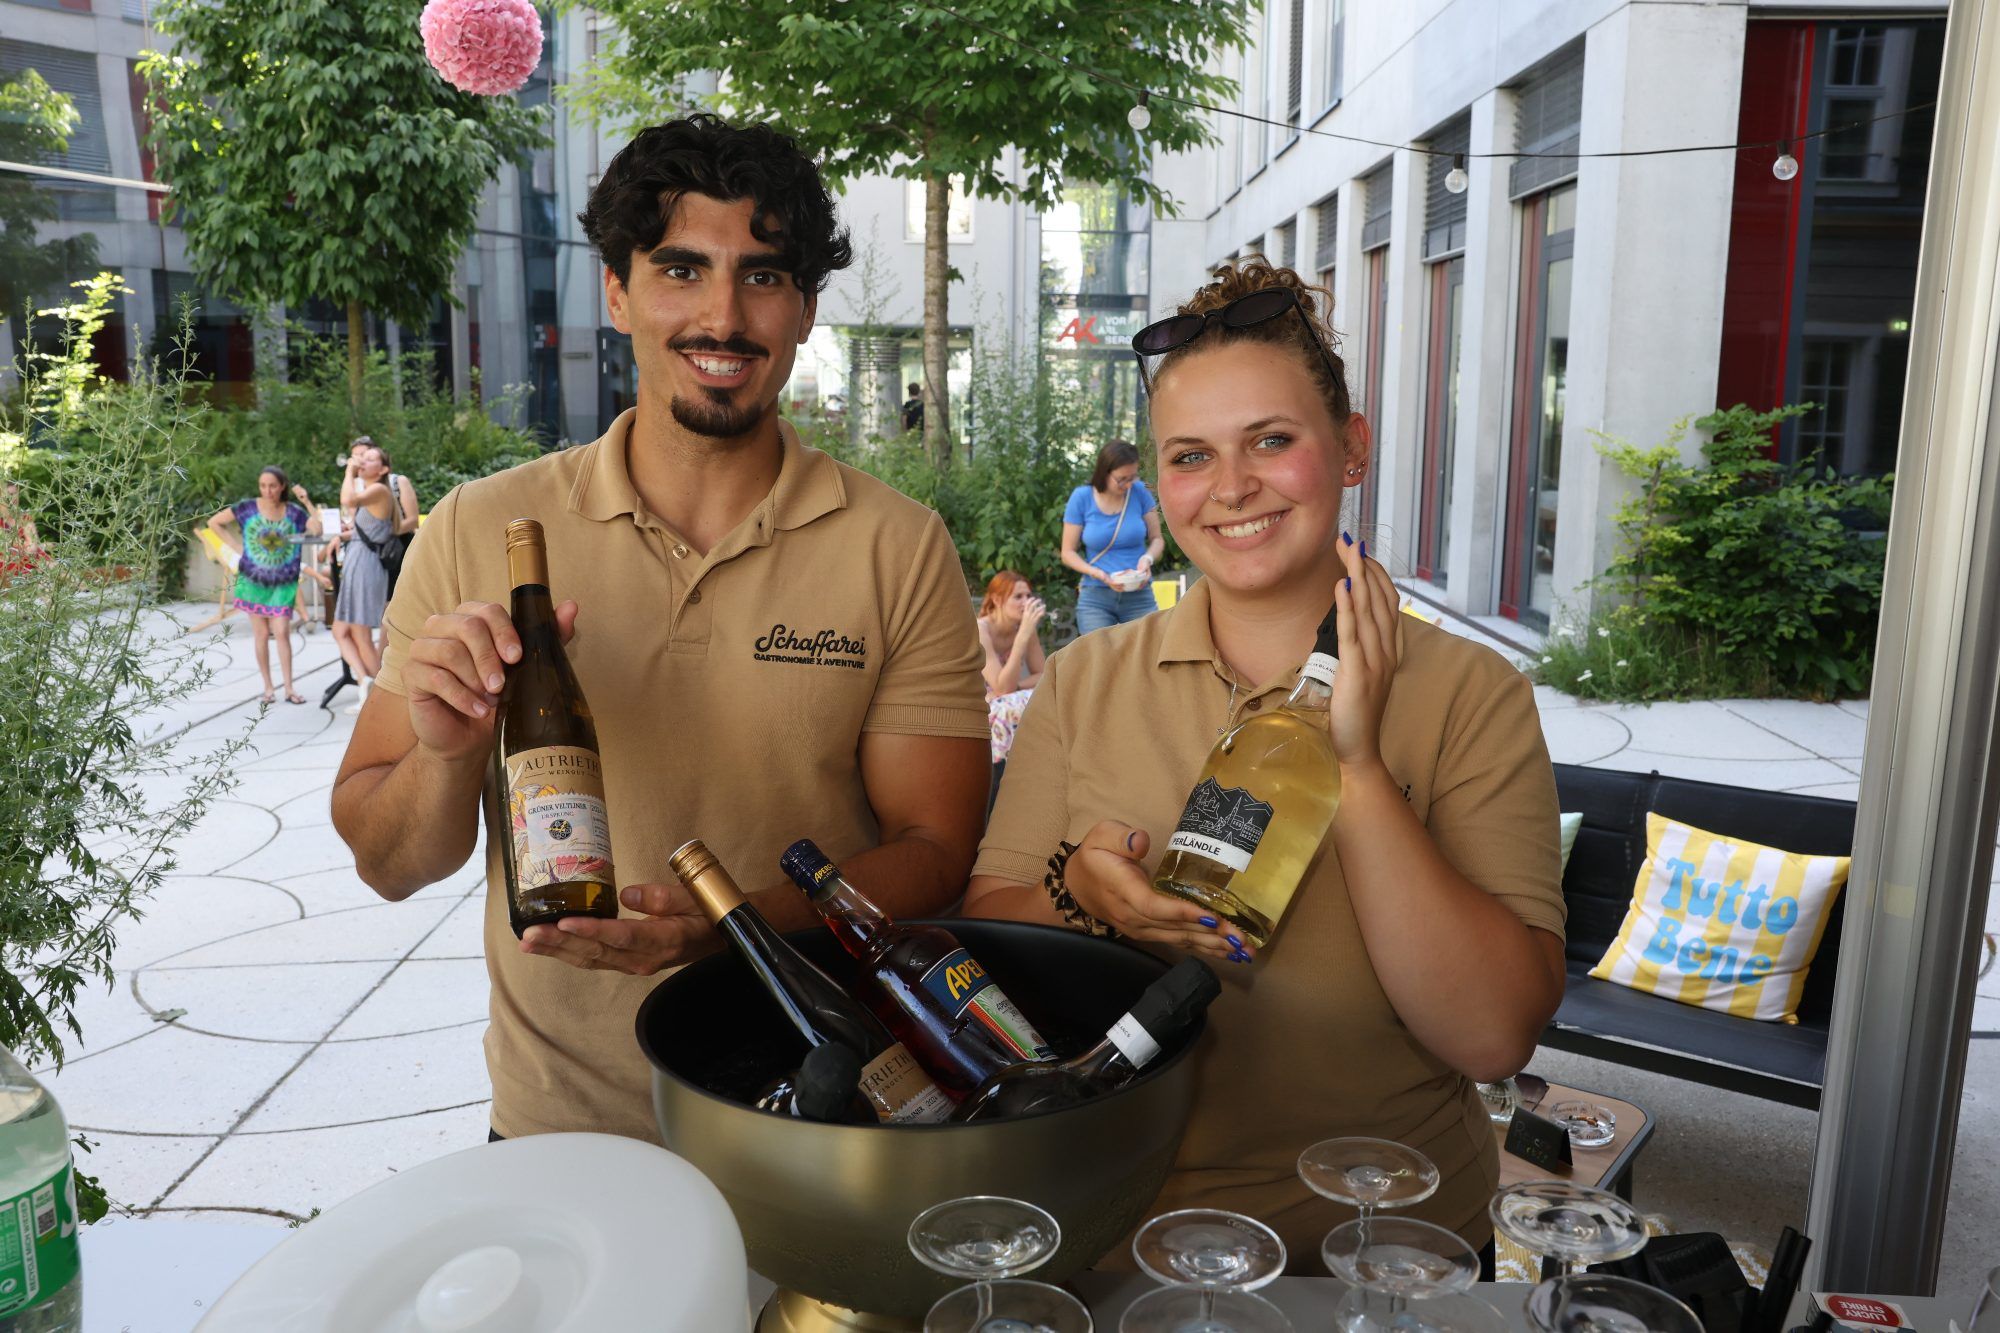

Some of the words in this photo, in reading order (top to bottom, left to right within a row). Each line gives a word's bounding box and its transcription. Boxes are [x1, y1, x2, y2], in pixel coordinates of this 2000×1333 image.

[1056, 316, 1099, 345] AK
[1104, 316, 1127, 326] VOR
[754, 624, 866, 657] Schaffarei
[754, 653, 816, 665] GASTRONOMIE
[816, 658, 822, 666] X
[823, 658, 865, 669] AVENTURE
[525, 755, 599, 773] AUTRIETH
[528, 803, 554, 815] GRÜNER
[554, 802, 588, 810] VELTLINER
[1661, 857, 1798, 935] Tutto
[1642, 916, 1773, 986] Bene
[860, 1051, 910, 1092] TRIETH
[26, 1256, 37, 1292] RECYCLE
[1838, 1301, 1885, 1314] STRIKE
[1845, 1309, 1888, 1322] LUCKY
